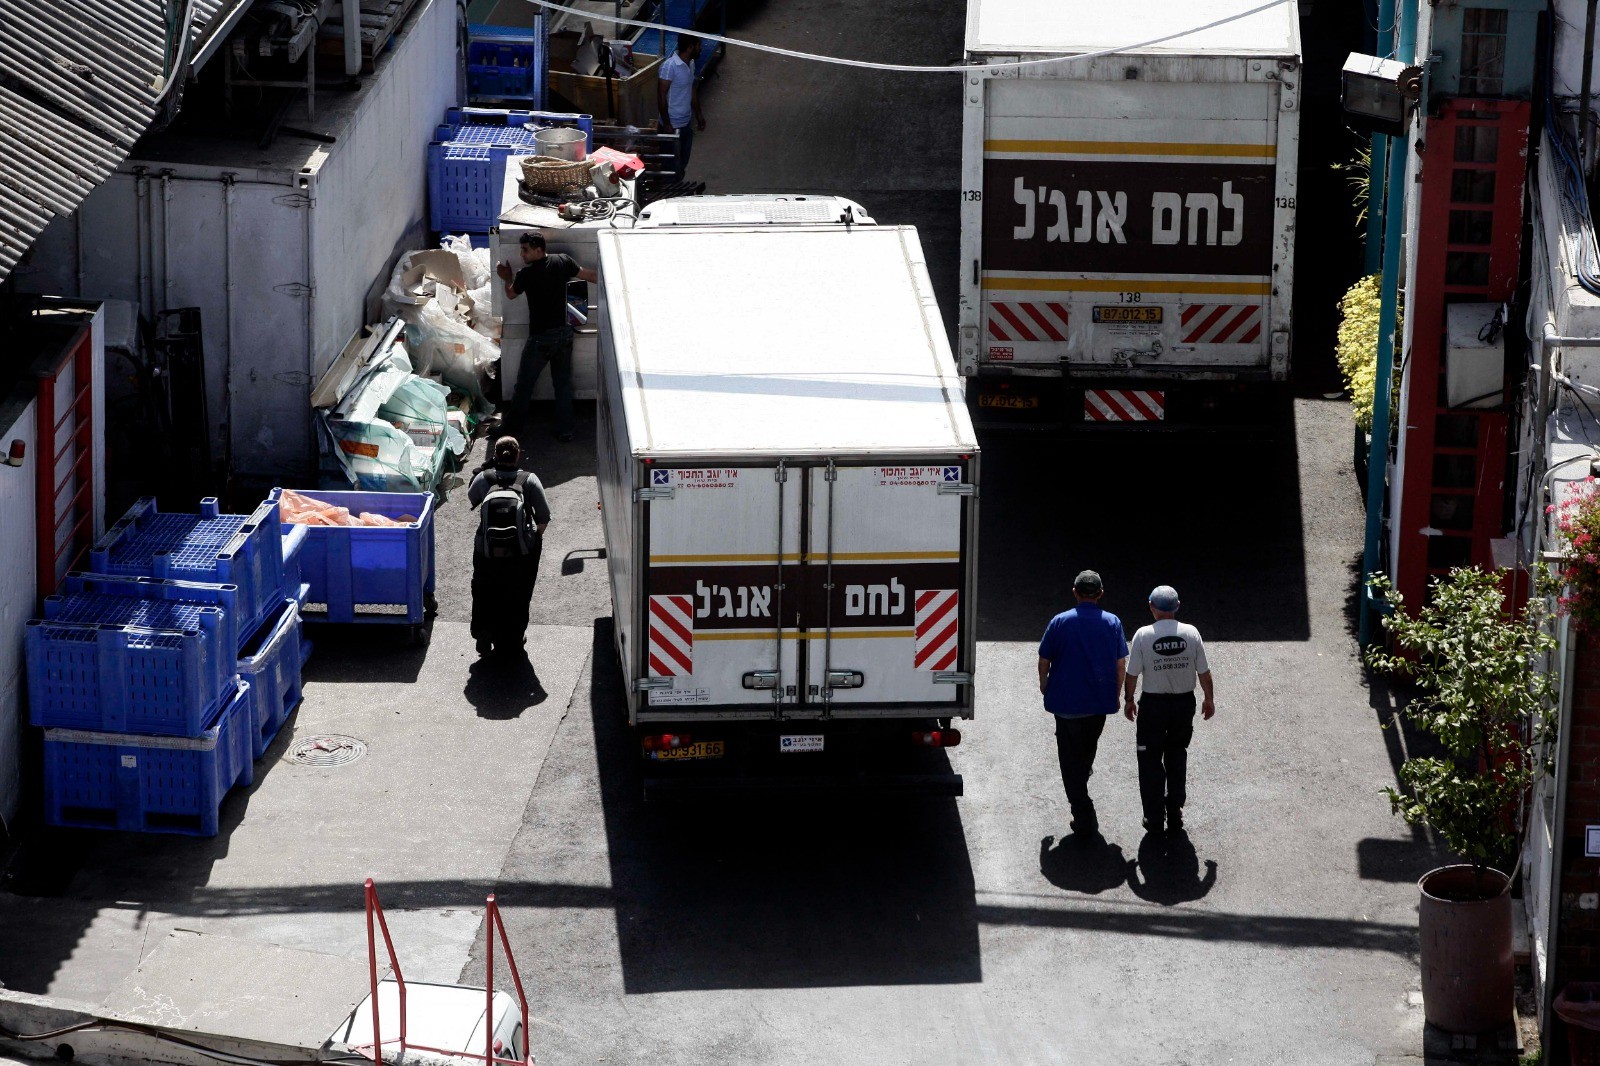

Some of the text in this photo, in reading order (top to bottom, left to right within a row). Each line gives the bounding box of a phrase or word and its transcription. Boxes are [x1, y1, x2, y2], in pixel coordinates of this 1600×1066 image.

[963, 190, 981, 202] 138
[1275, 197, 1296, 209] 138
[1013, 176, 1244, 246] לחם אנג'ל
[1119, 291, 1141, 303] 138
[696, 576, 906, 618] לחם אנג'ל
